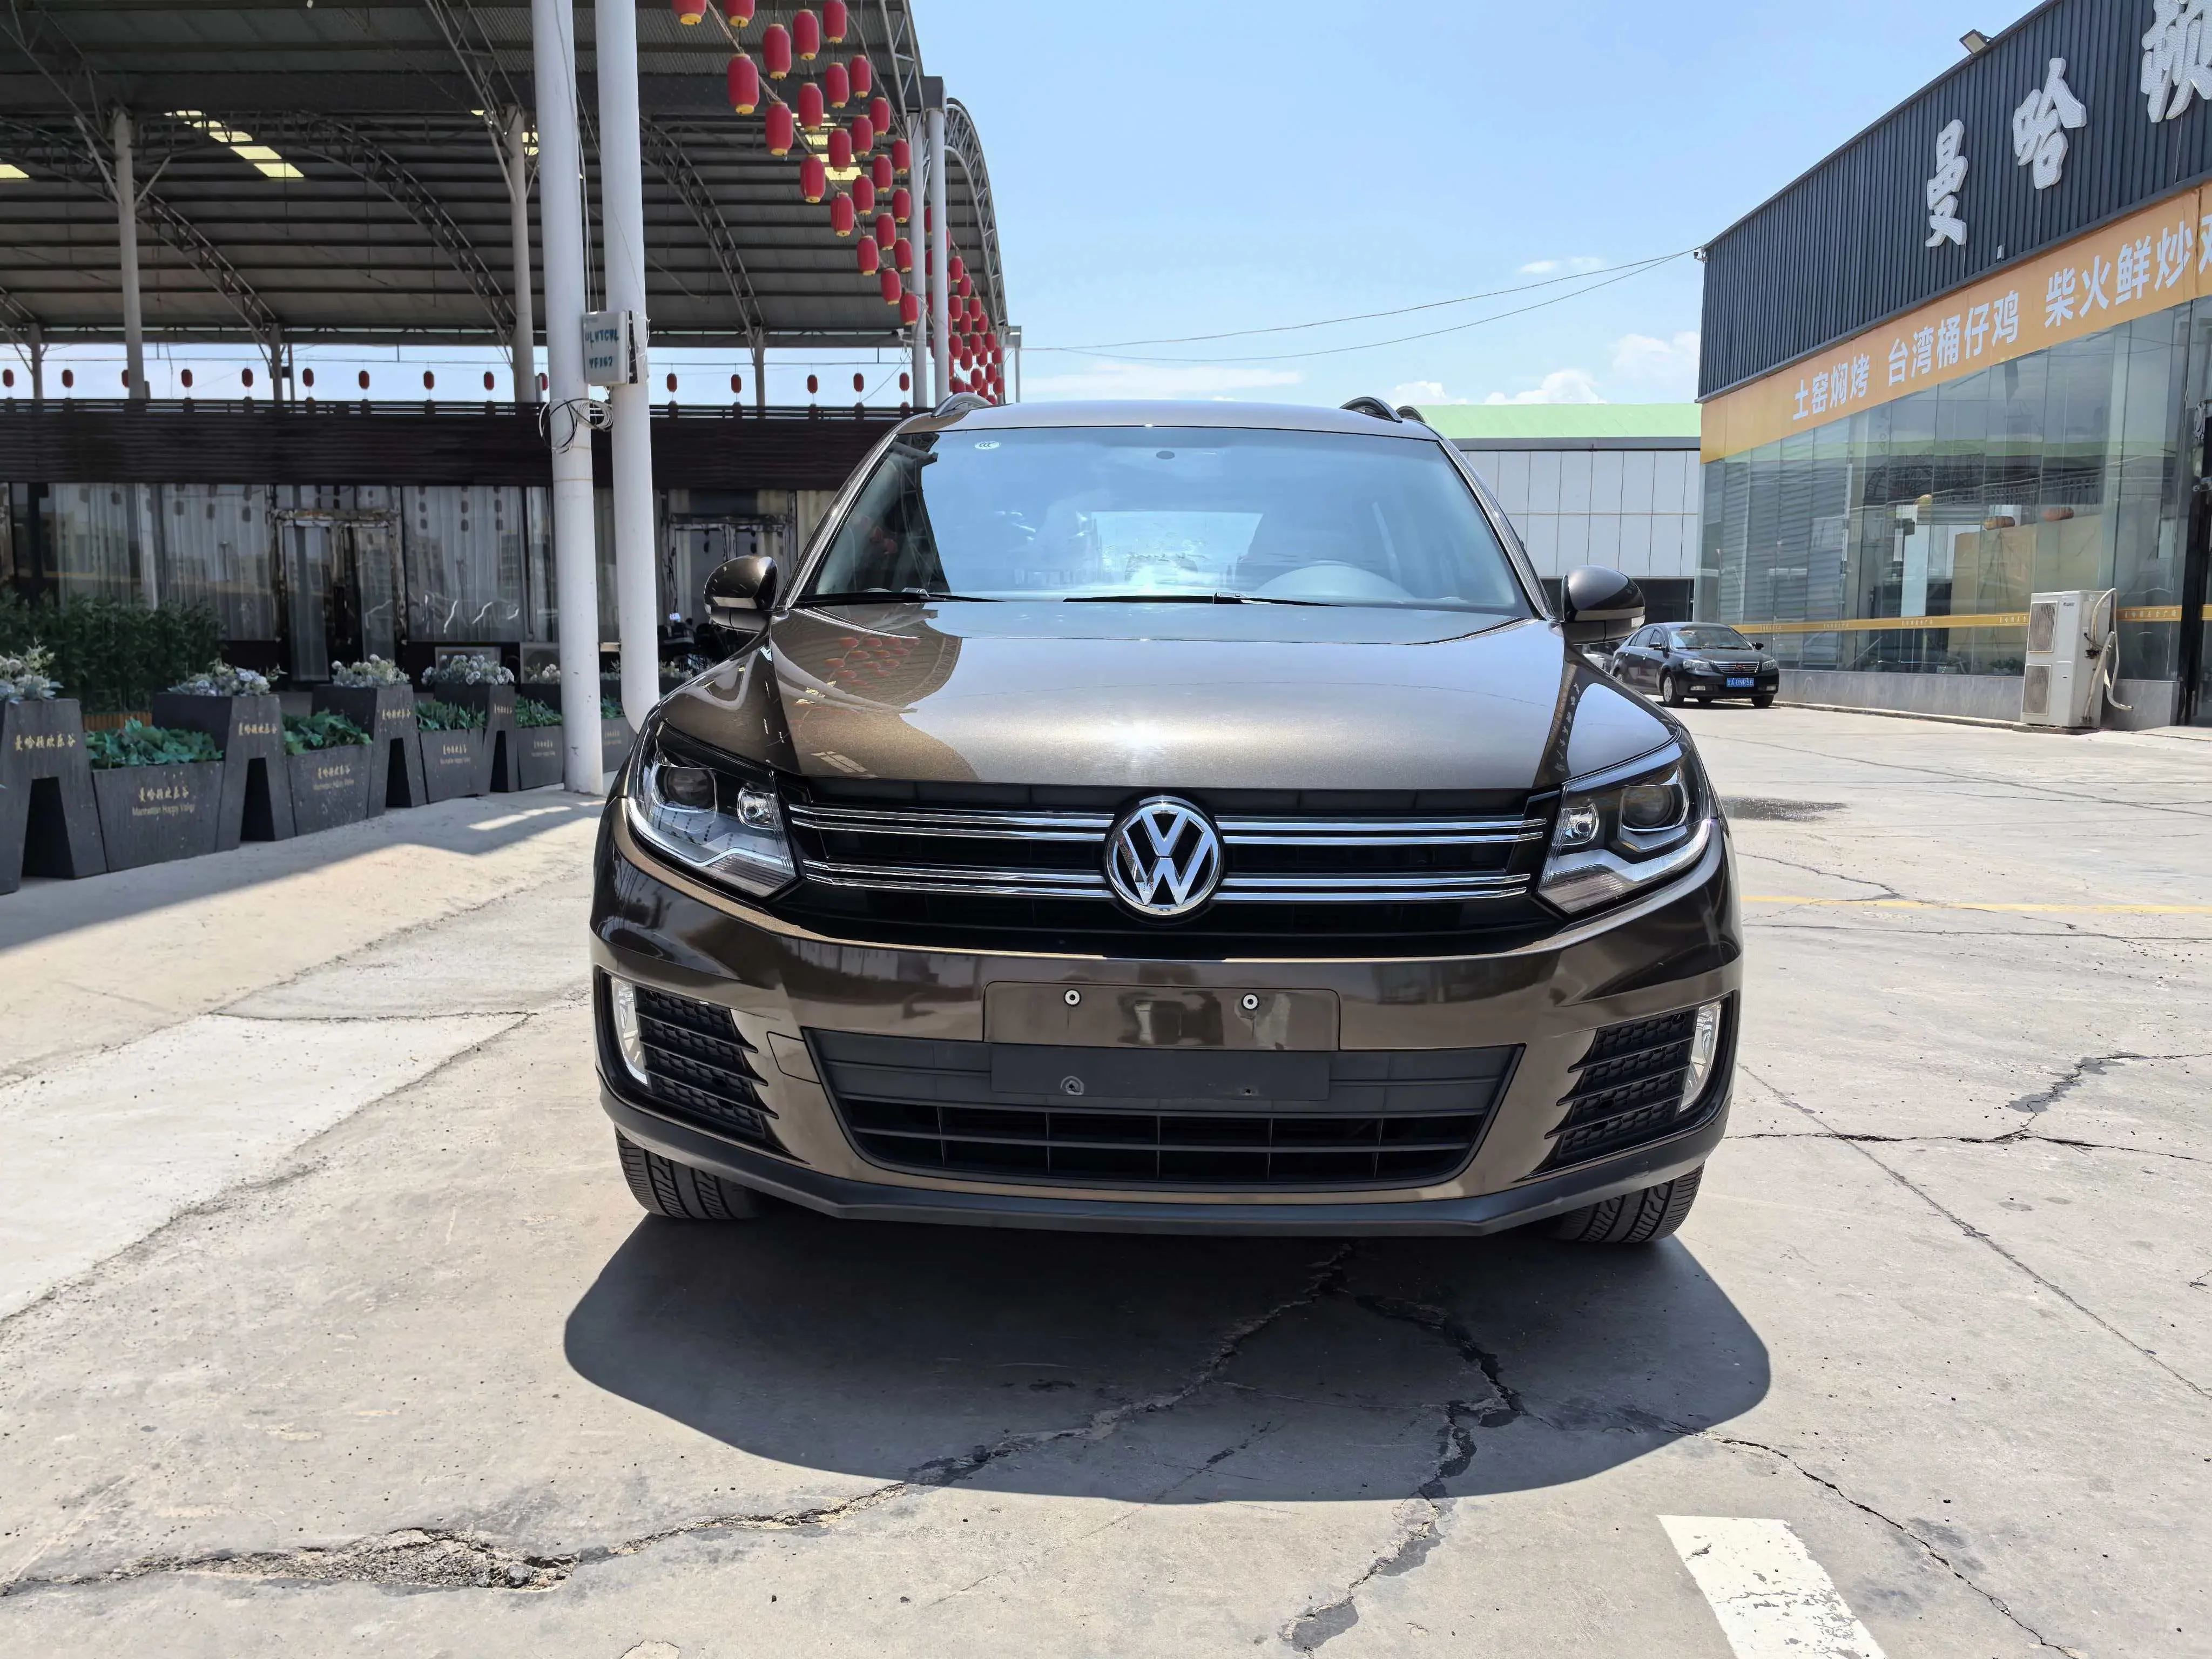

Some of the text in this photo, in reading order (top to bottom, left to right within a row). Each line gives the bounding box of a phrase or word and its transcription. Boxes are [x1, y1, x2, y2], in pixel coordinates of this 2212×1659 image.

[1792, 353, 1871, 421] 土窑焖烤
[1888, 289, 2019, 387] 台湾桶仔鸡
